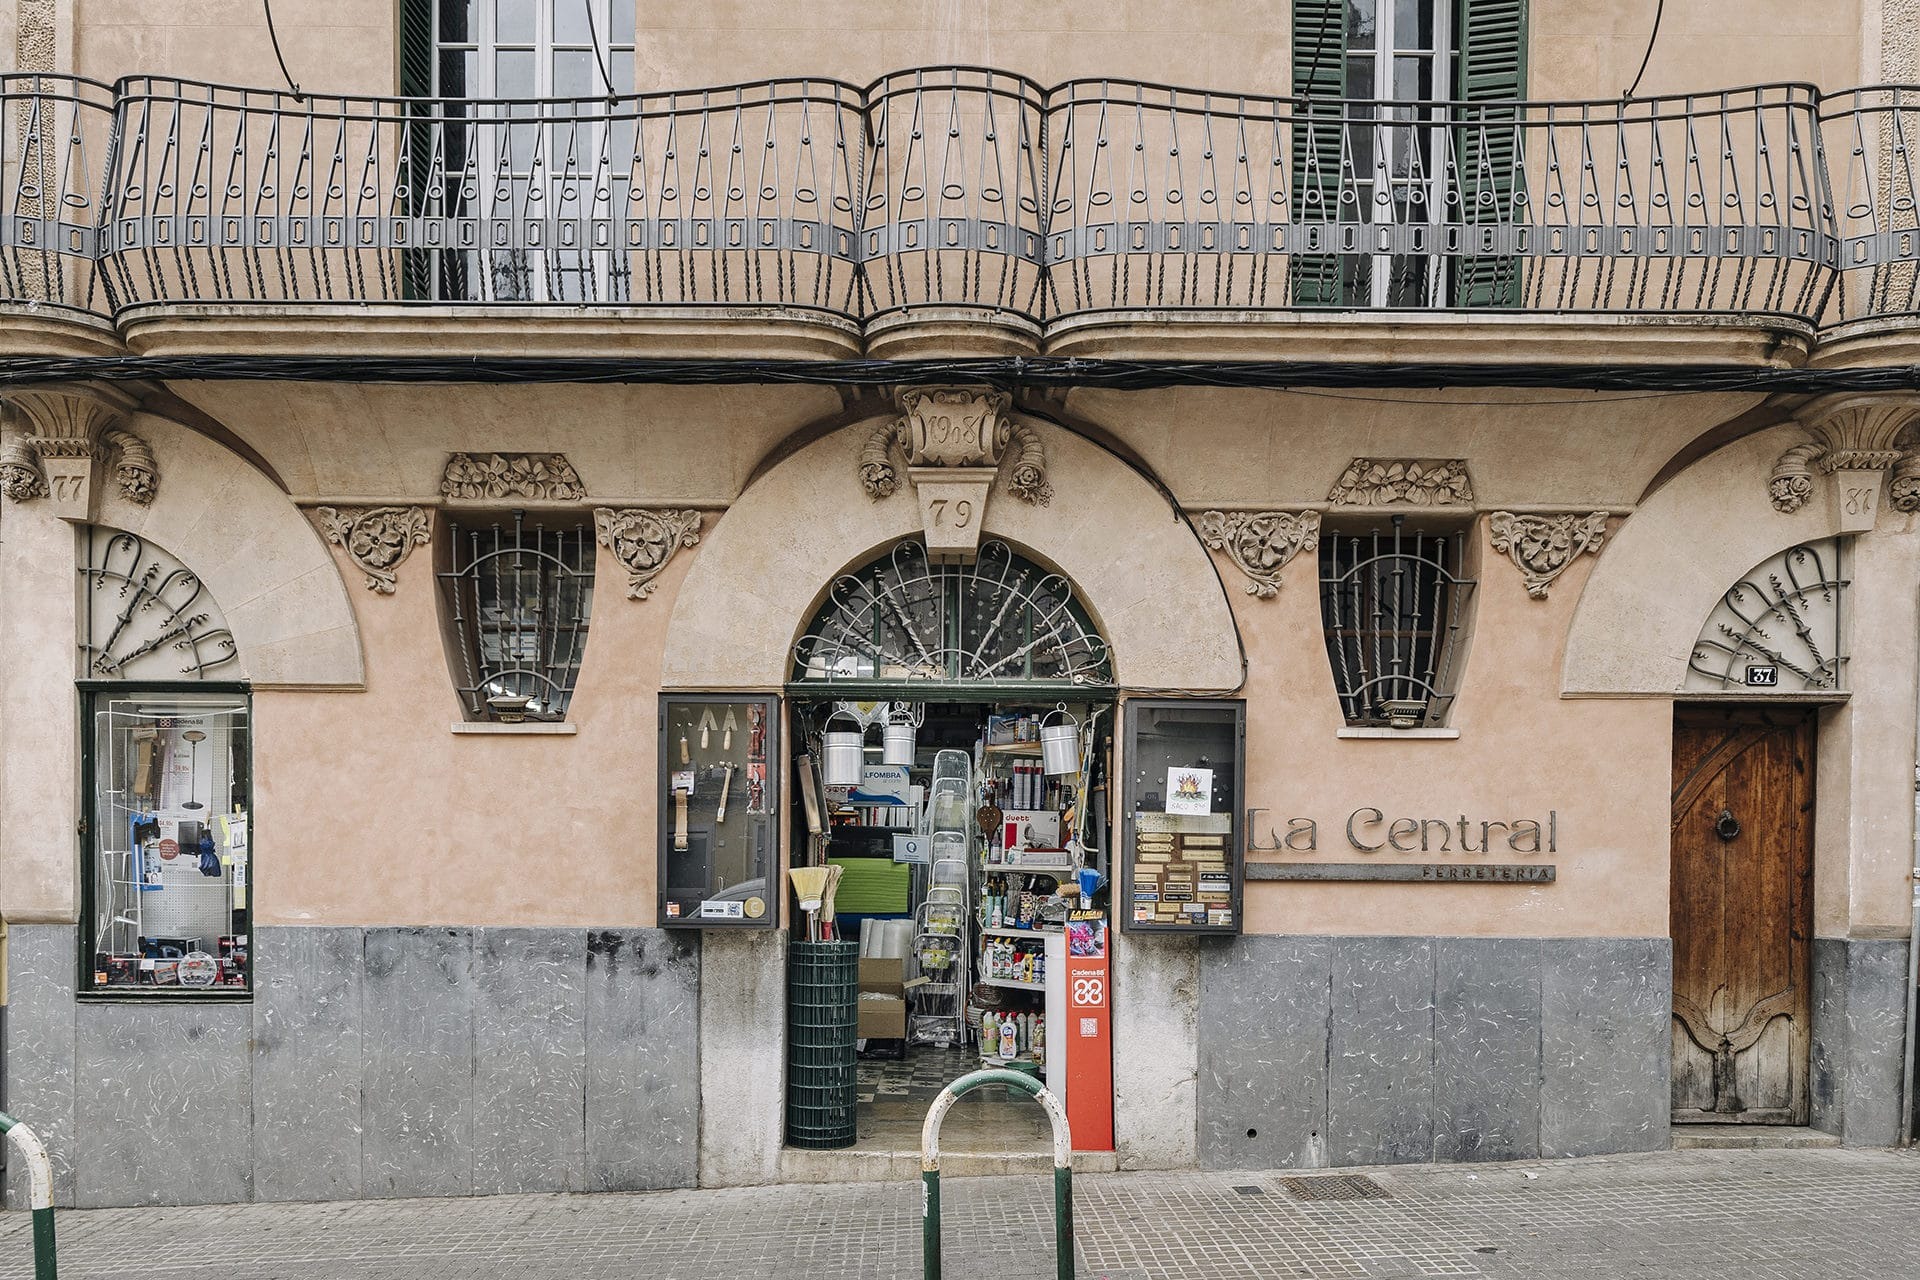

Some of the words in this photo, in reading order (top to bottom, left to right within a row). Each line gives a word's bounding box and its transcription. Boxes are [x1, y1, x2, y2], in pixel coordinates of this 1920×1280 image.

[52, 475, 87, 502] 77
[929, 499, 972, 528] 79
[1753, 669, 1773, 684] 37
[1247, 808, 1317, 851] La
[1346, 807, 1556, 853] Central
